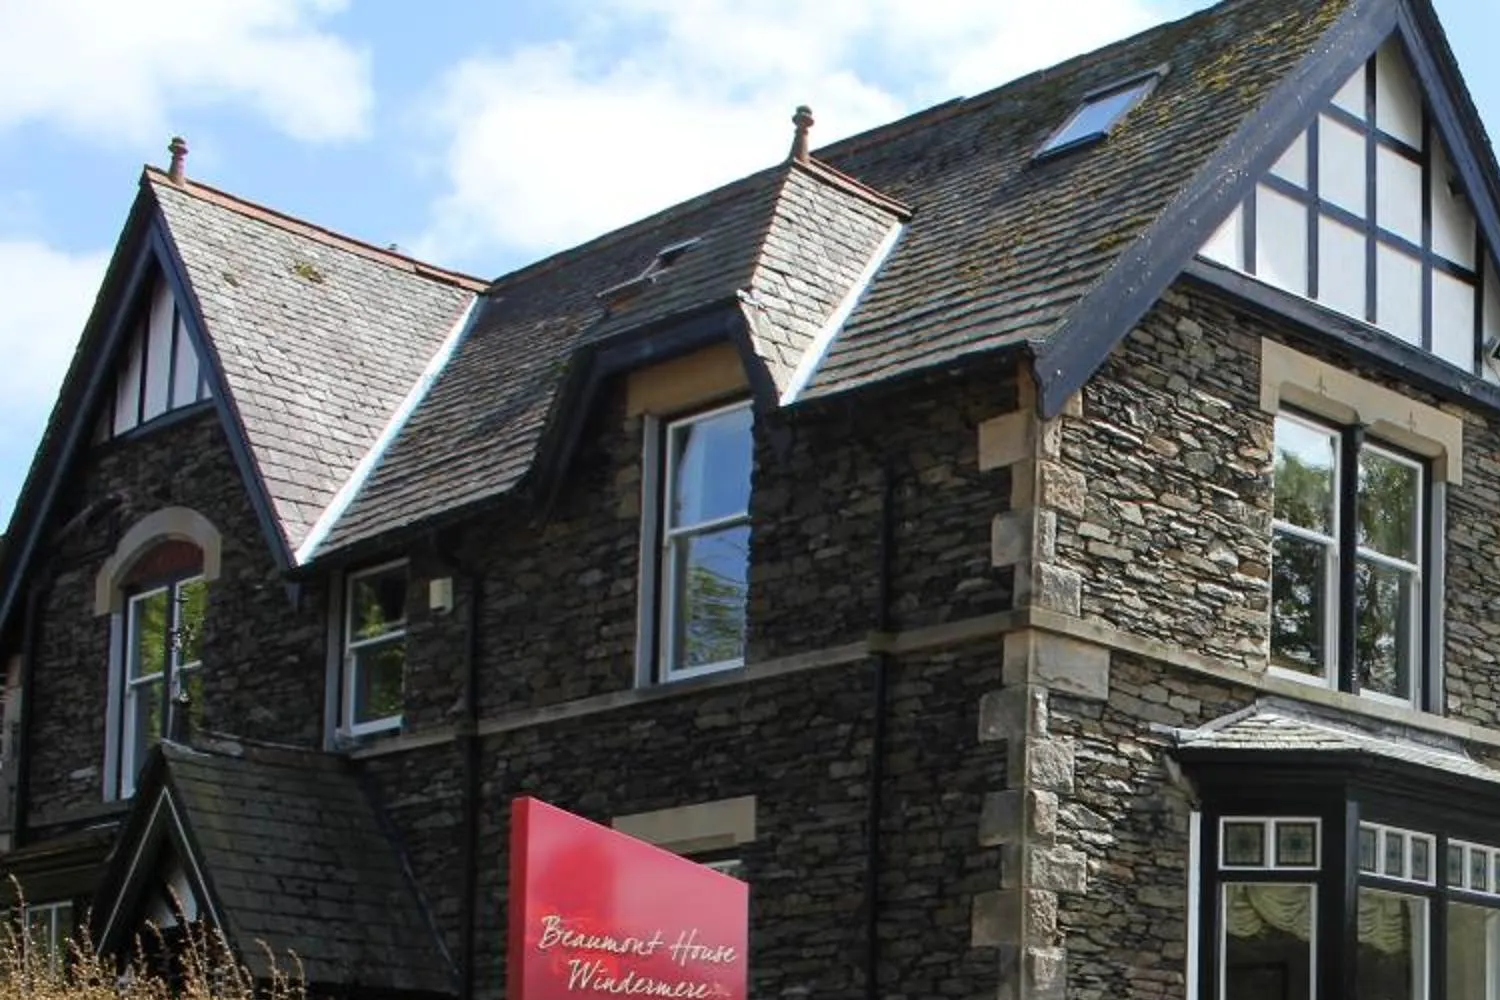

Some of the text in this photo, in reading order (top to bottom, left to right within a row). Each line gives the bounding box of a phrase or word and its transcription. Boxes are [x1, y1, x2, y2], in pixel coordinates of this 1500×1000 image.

[537, 914, 737, 966] Beaumont House
[567, 957, 710, 999] Windermere
